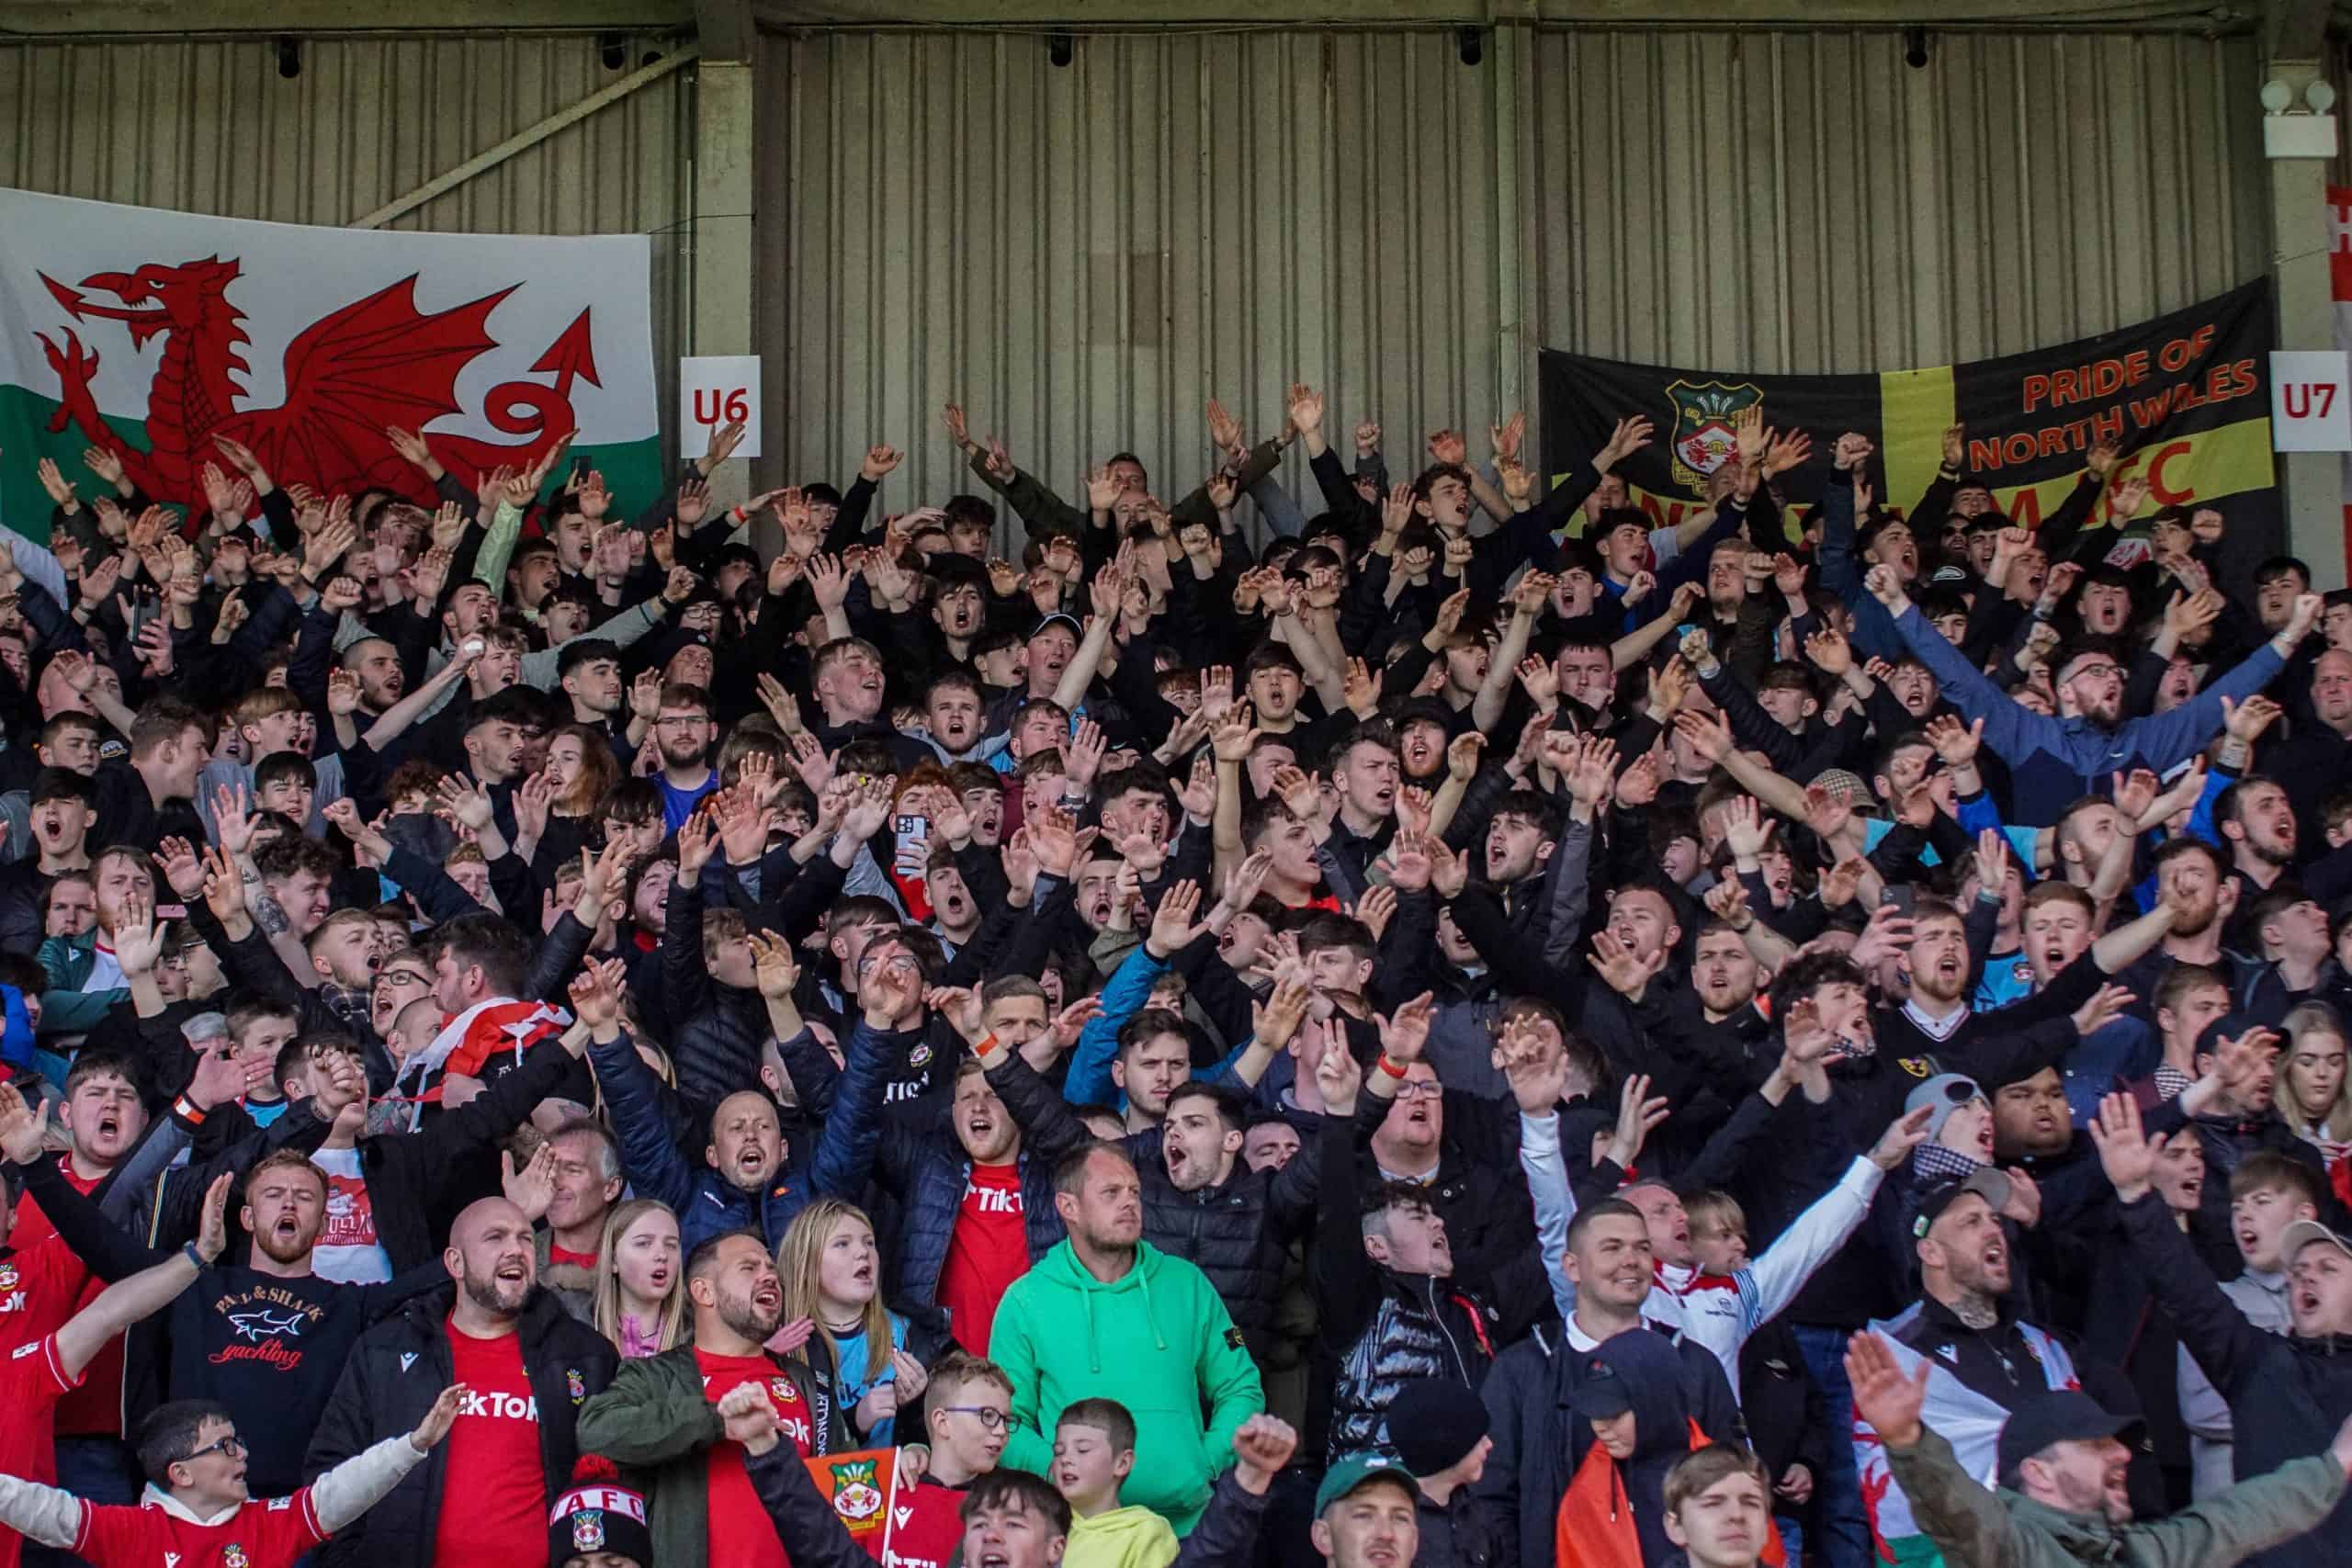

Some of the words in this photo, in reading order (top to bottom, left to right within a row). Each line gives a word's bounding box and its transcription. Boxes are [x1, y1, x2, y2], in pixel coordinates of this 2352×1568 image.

[2023, 350, 2149, 413] PRIDE
[2160, 323, 2215, 372] OF
[694, 388, 749, 424] U6
[2284, 383, 2336, 418] U7
[1969, 405, 2124, 472] NORTH
